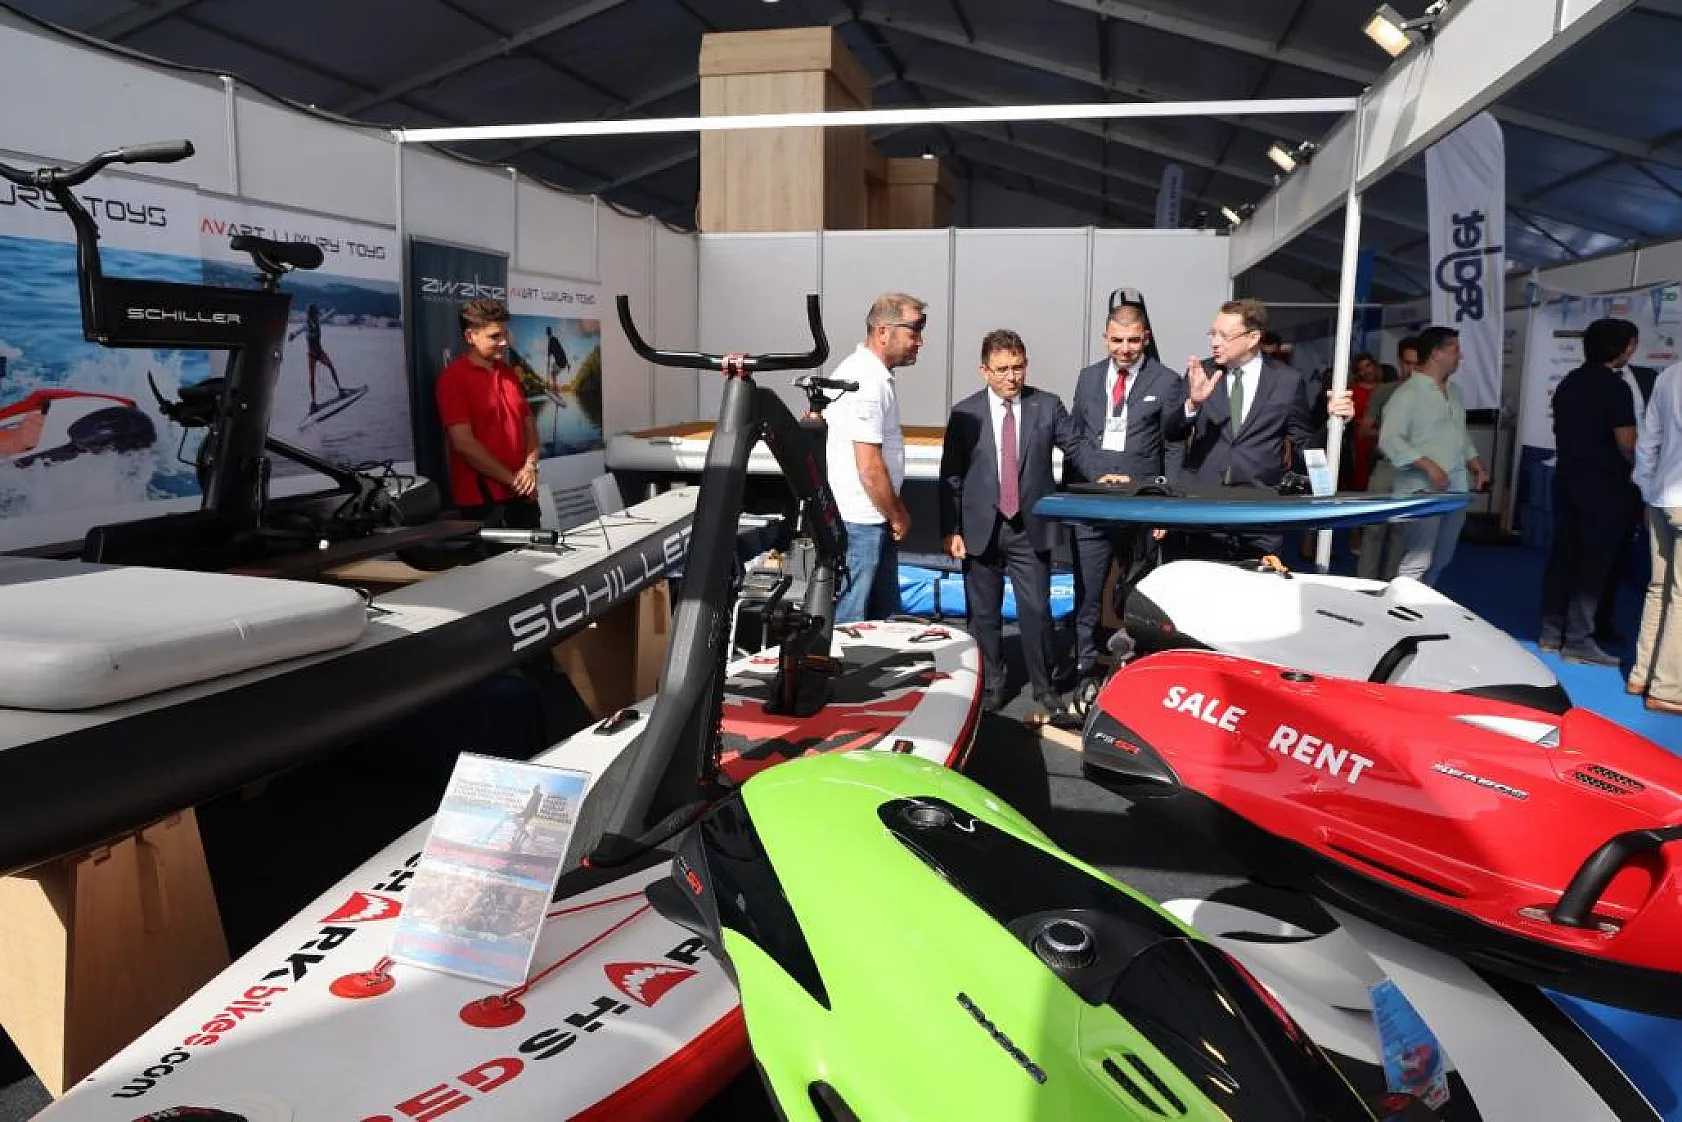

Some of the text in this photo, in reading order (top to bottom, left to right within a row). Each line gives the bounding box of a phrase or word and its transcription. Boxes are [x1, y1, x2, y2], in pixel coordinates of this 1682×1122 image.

[83, 195, 167, 227] TOYS
[347, 241, 387, 259] TOYS
[421, 274, 506, 300] awake
[126, 308, 240, 325] SCHILLER
[1163, 686, 1375, 785] SALE RENT
